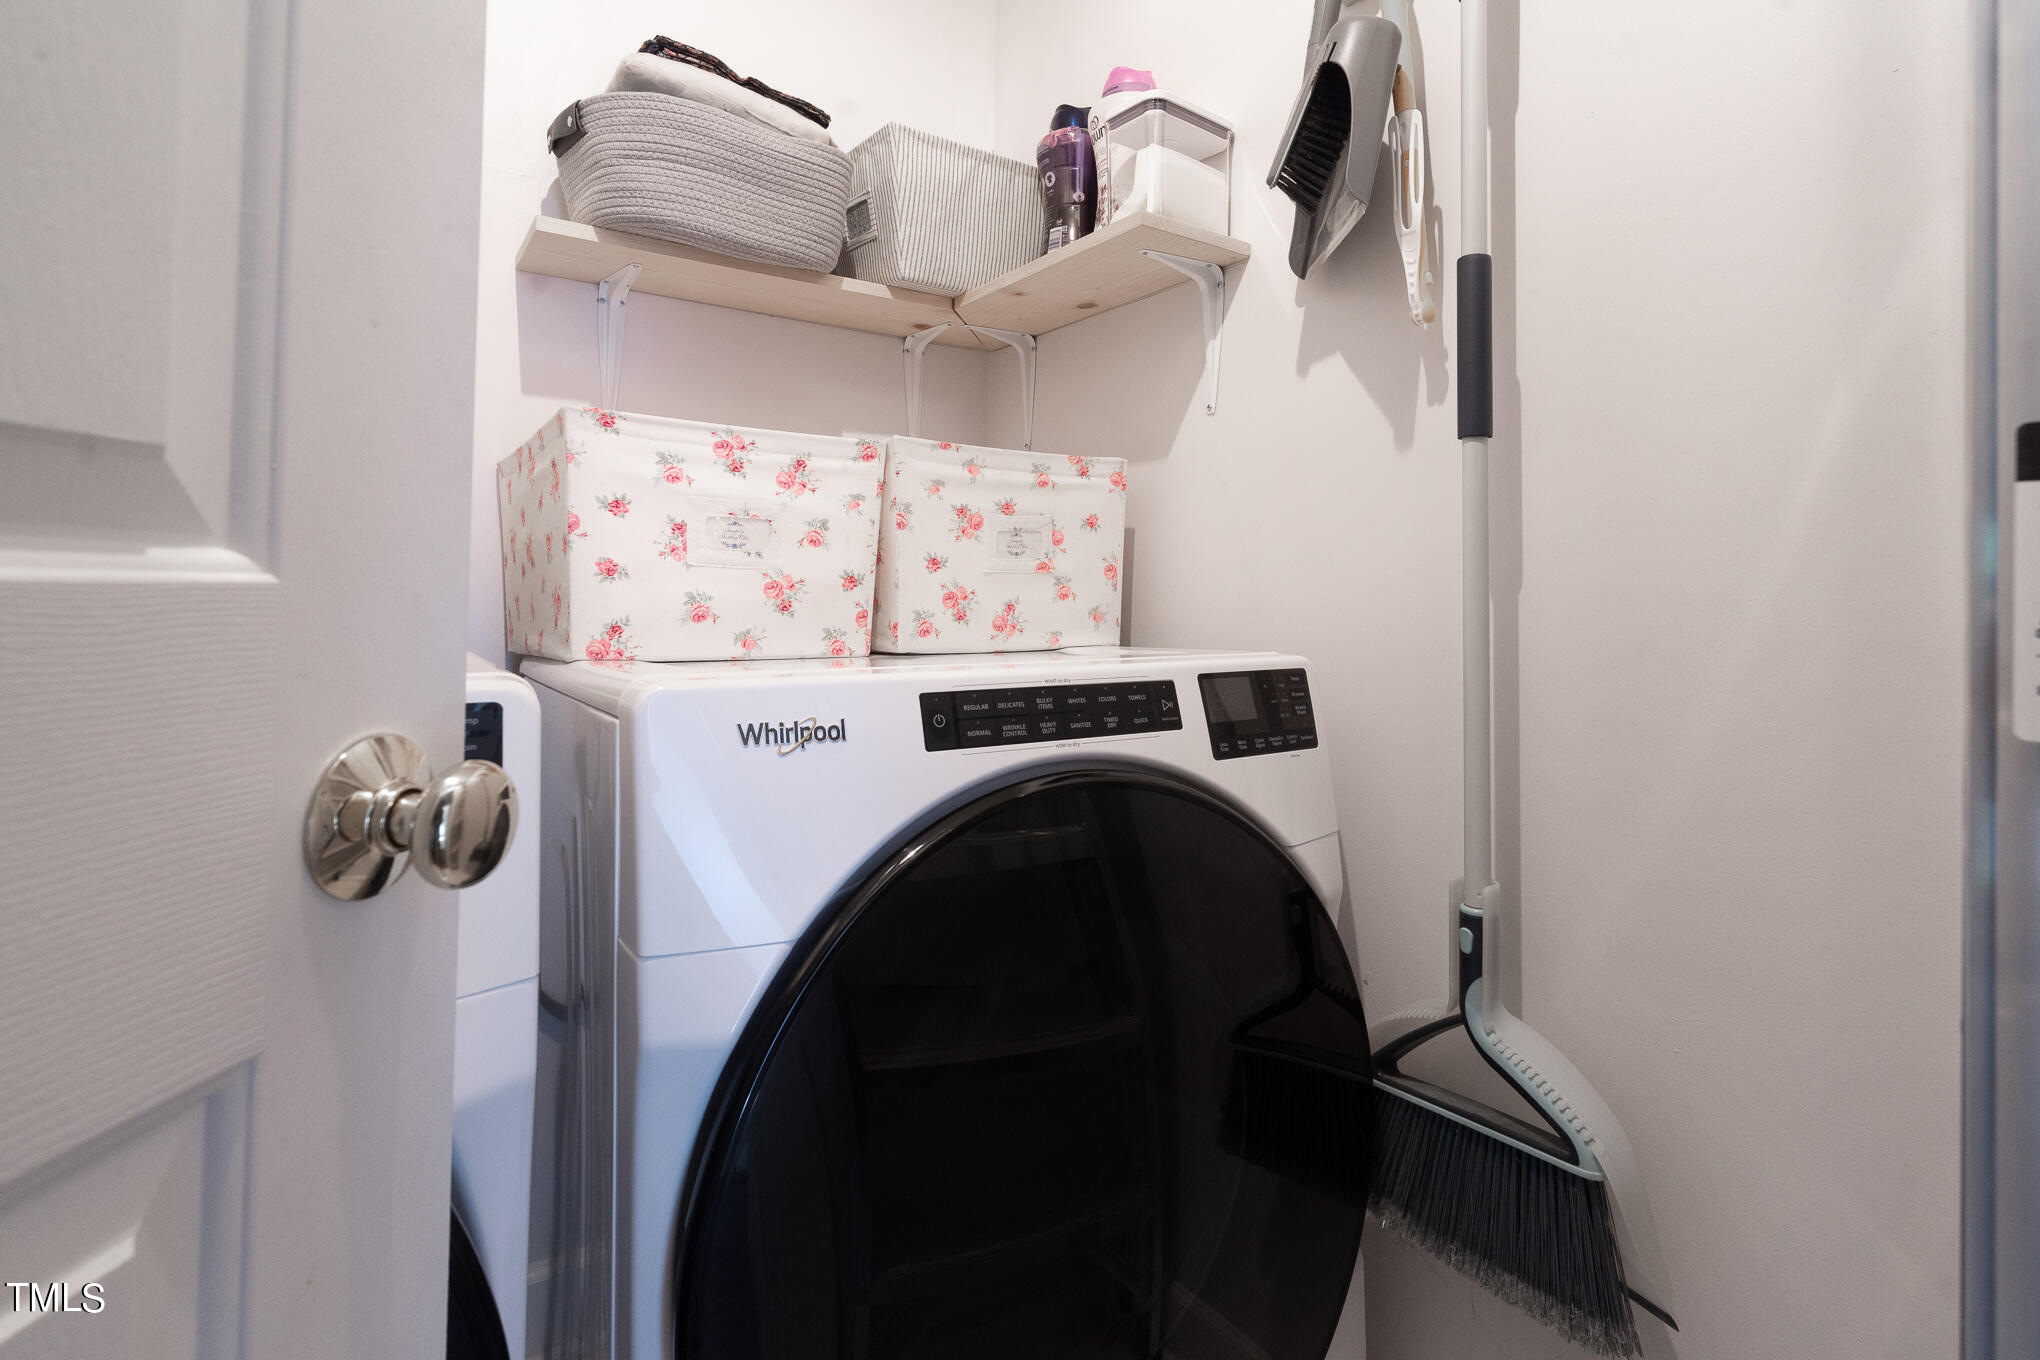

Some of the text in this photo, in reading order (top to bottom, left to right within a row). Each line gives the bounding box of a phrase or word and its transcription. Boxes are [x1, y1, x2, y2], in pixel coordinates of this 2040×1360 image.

[963, 703, 989, 711] REGULAR
[997, 701, 1025, 709] DELICATES
[1070, 721, 1091, 729] SANITIZE
[737, 718, 847, 750] Whirlpool
[967, 729, 992, 737] NORMAL
[1042, 727, 1057, 735] DUTY
